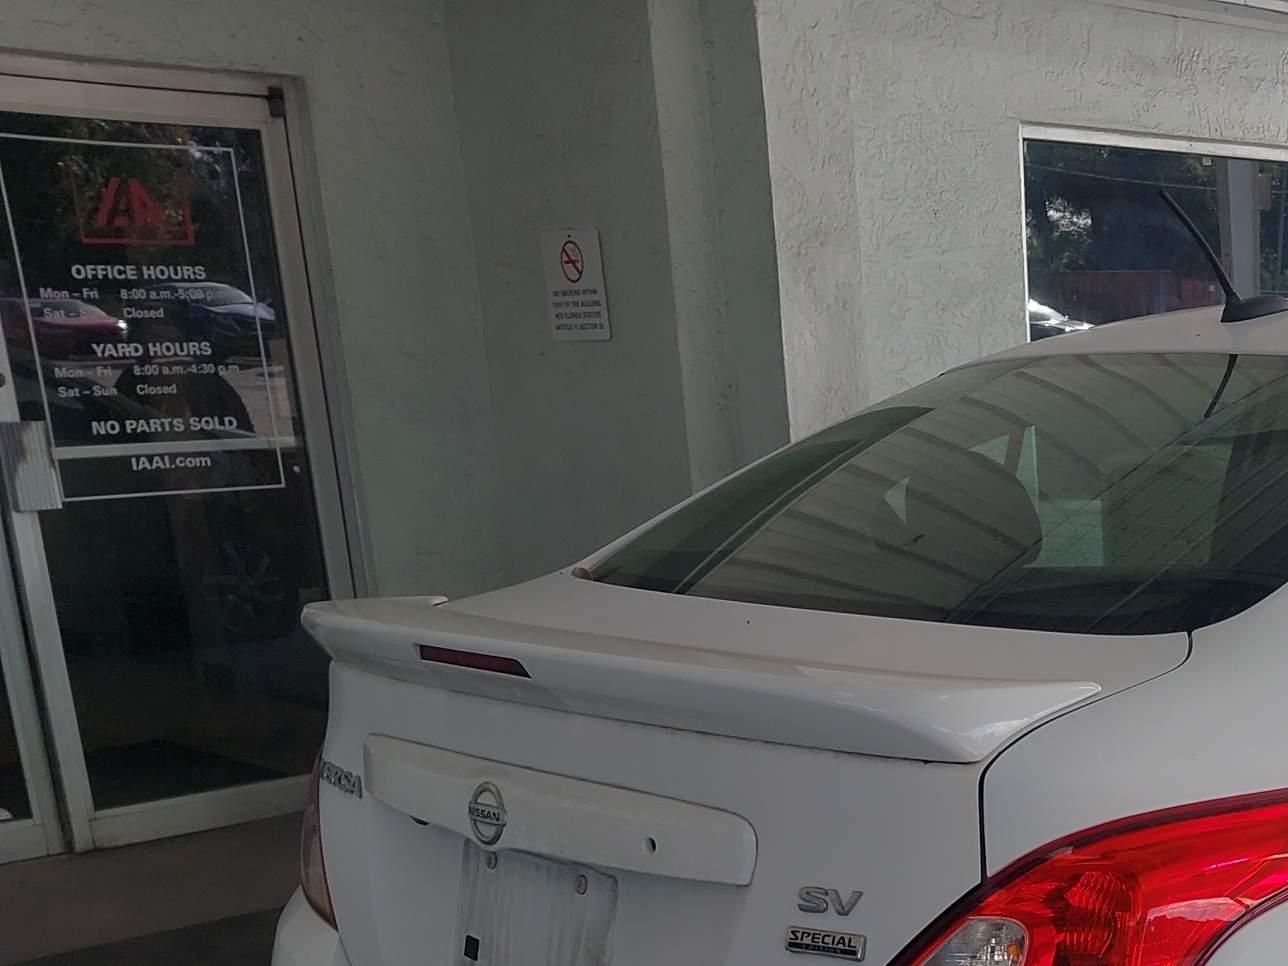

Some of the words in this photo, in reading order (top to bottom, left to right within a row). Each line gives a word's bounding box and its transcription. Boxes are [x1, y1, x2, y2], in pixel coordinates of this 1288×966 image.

[71, 264, 138, 280] OFFICE
[143, 265, 207, 280] HOURS
[39, 287, 70, 299] Mon
[82, 287, 100, 299] Fri
[120, 288, 146, 300] 8:00
[43, 307, 65, 320] Sat
[123, 307, 165, 319] Closed
[91, 343, 144, 358] YARD
[149, 341, 212, 357] HOURS
[54, 367, 84, 379] Mon
[96, 365, 112, 377] Fri
[133, 364, 160, 376] 8:00
[57, 386, 81, 399] Sat
[93, 385, 118, 397] Sun
[136, 383, 177, 395] Closed
[91, 420, 121, 435] NO
[125, 417, 185, 434] PARTS
[189, 415, 238, 431] SOLD
[130, 455, 212, 471] IAAI.com
[798, 886, 864, 916] SV
[788, 929, 858, 950] SPECIAL
